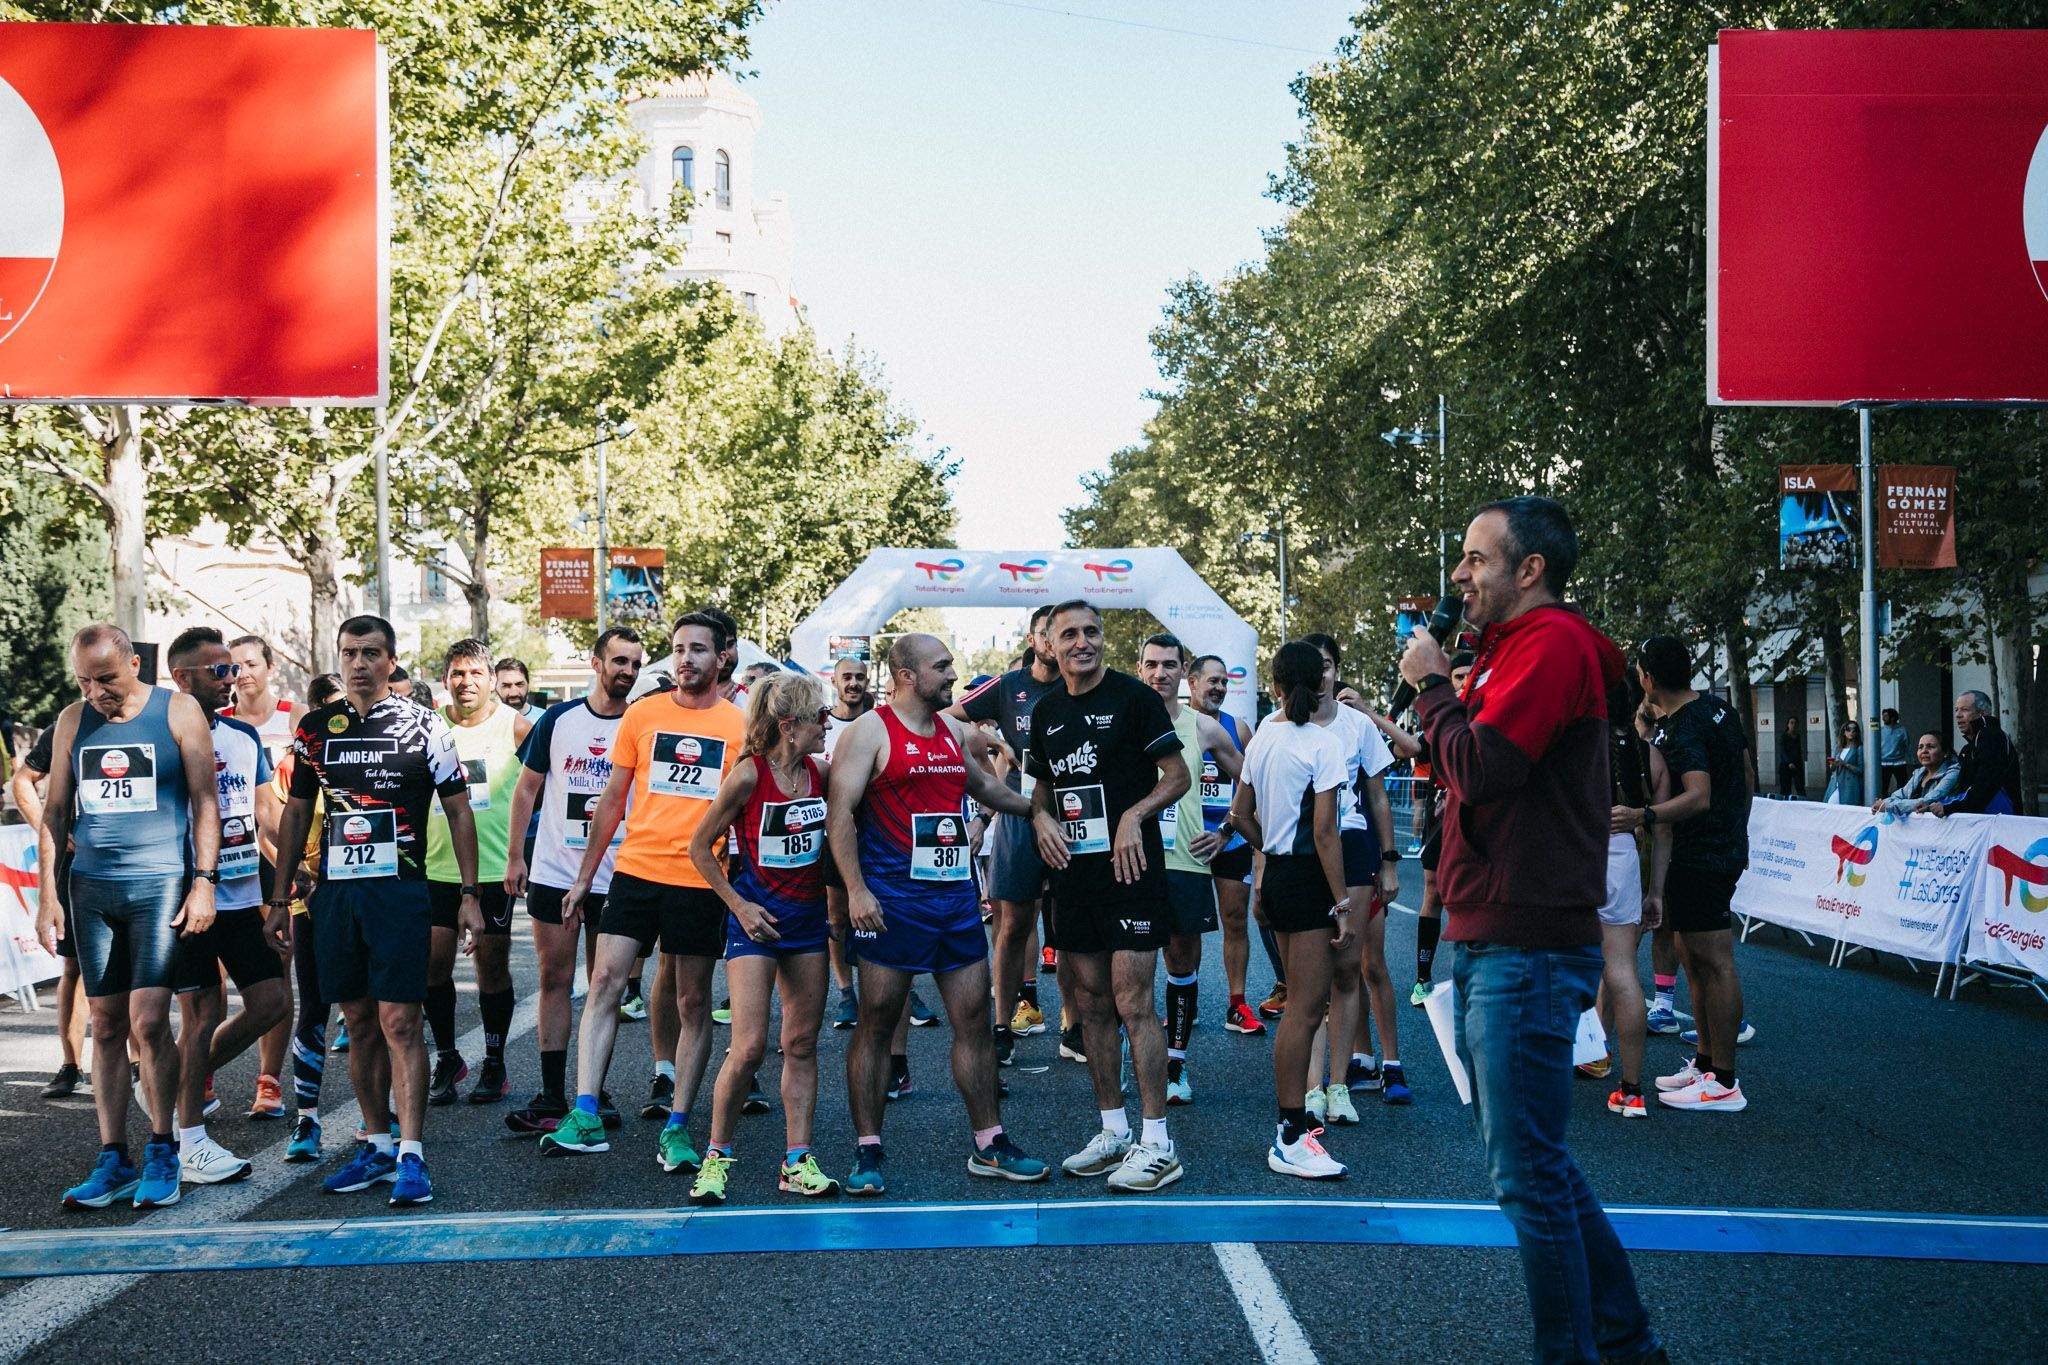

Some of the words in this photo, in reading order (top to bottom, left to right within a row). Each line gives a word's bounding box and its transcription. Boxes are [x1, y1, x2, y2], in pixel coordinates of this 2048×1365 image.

[1784, 476, 1816, 490] ISLA
[1887, 484, 1947, 498] FERNÁN
[1887, 496, 1947, 510] GÓMEZ
[1919, 528, 1945, 536] VILLA
[546, 559, 589, 569] FERNÁN
[612, 555, 636, 565] ISLA
[546, 568, 589, 578] GÓMEZ
[915, 585, 965, 594] TotalEnergies
[999, 586, 1049, 594] TotalEnergies
[1083, 586, 1134, 594] TotalEnergies
[1399, 602, 1417, 611] ISLA
[338, 750, 383, 764] ANDEAN
[668, 764, 703, 786] 222
[909, 765, 927, 774] A.D.
[928, 765, 966, 774] MARATHON
[568, 775, 590, 787] Milla
[100, 779, 133, 799] 215
[801, 806, 825, 821] 3185
[781, 833, 812, 856] 185
[218, 851, 241, 864] STAVO
[343, 844, 376, 866] 212
[933, 847, 960, 868] 387
[1815, 894, 1862, 919] TotalEnergies
[1899, 917, 1939, 932] totalenergies.es
[854, 929, 877, 939] ADM
